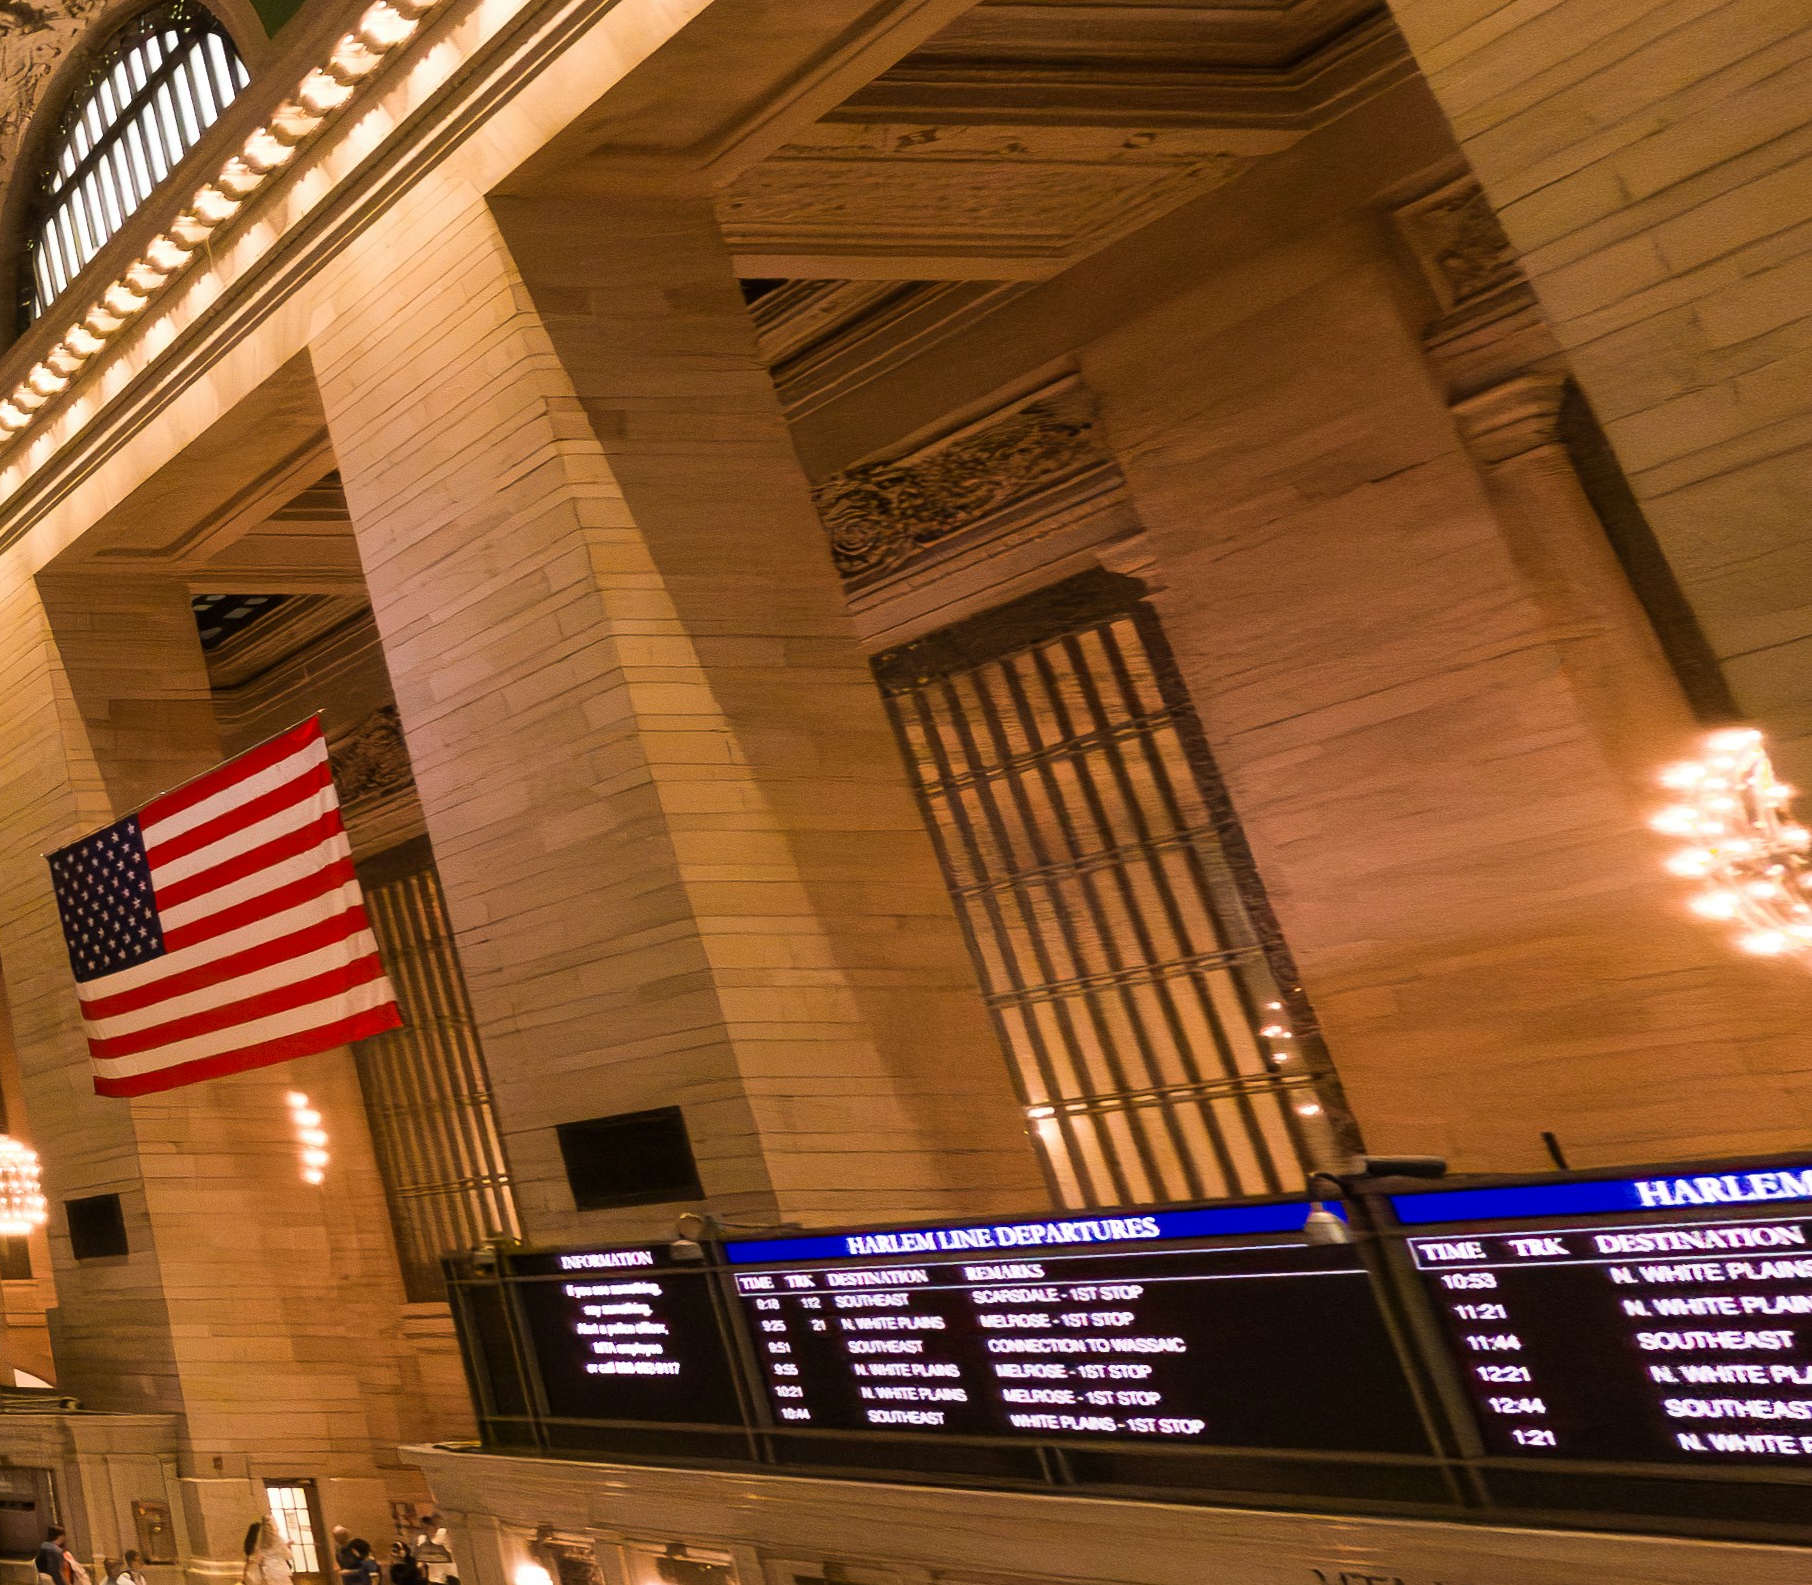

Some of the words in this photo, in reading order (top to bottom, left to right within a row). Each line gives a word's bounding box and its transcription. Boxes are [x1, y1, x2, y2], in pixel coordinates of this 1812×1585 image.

[1634, 1170, 1812, 1207] HARLEM
[847, 1231, 938, 1255] HARLEM
[936, 1228, 998, 1250] LINE
[995, 1217, 1160, 1248] DEPARTURES
[1418, 1241, 1487, 1261] TIME
[1508, 1238, 1570, 1257] TRK
[1594, 1225, 1806, 1254] DESTINATION
[560, 1251, 654, 1269] INFORMATION
[739, 1276, 775, 1290] TIME
[784, 1275, 816, 1288] TRK
[827, 1269, 929, 1287] DESTINATION
[964, 1264, 1046, 1281] REMARKS
[1638, 1262, 1725, 1282] WHITE
[834, 1293, 909, 1309] SOUTHEAST
[972, 1288, 1061, 1304] SCARSDALE
[1070, 1287, 1097, 1301] 1ST
[1100, 1285, 1144, 1300] STOP
[1653, 1297, 1739, 1316] WHITE
[1742, 1295, 1812, 1315] PLAIN
[855, 1317, 898, 1330] WHITE
[898, 1316, 946, 1331] PLAINS
[979, 1314, 1052, 1328] MELROSE
[1061, 1313, 1089, 1327] 1ST
[1091, 1312, 1135, 1327] STOP
[847, 1340, 924, 1354] SOUTHEAST
[987, 1339, 1086, 1353] CONNECTION
[1086, 1339, 1110, 1353] TO
[1110, 1338, 1187, 1353] WASSAIC
[1636, 1330, 1795, 1350] SOUTHEAST
[870, 1364, 913, 1377] WHITE
[912, 1364, 961, 1377] PLAINS
[994, 1364, 1068, 1378] MELROSE
[1077, 1365, 1107, 1379] 1ST
[1109, 1364, 1152, 1379] STOP
[1678, 1365, 1767, 1384] WHITE
[875, 1387, 919, 1401] WHITE
[919, 1387, 968, 1402] PLAINS
[1002, 1389, 1076, 1404] MELROSE
[1085, 1391, 1114, 1405] 1ST
[1118, 1391, 1161, 1406] STOP
[867, 1410, 944, 1425] SOUTHEAST
[1010, 1414, 1059, 1430] WHITE
[1060, 1415, 1117, 1431] PLAINS
[1126, 1418, 1155, 1432] 1ST
[1158, 1418, 1205, 1434] STOP
[1707, 1433, 1799, 1454] WHITE
